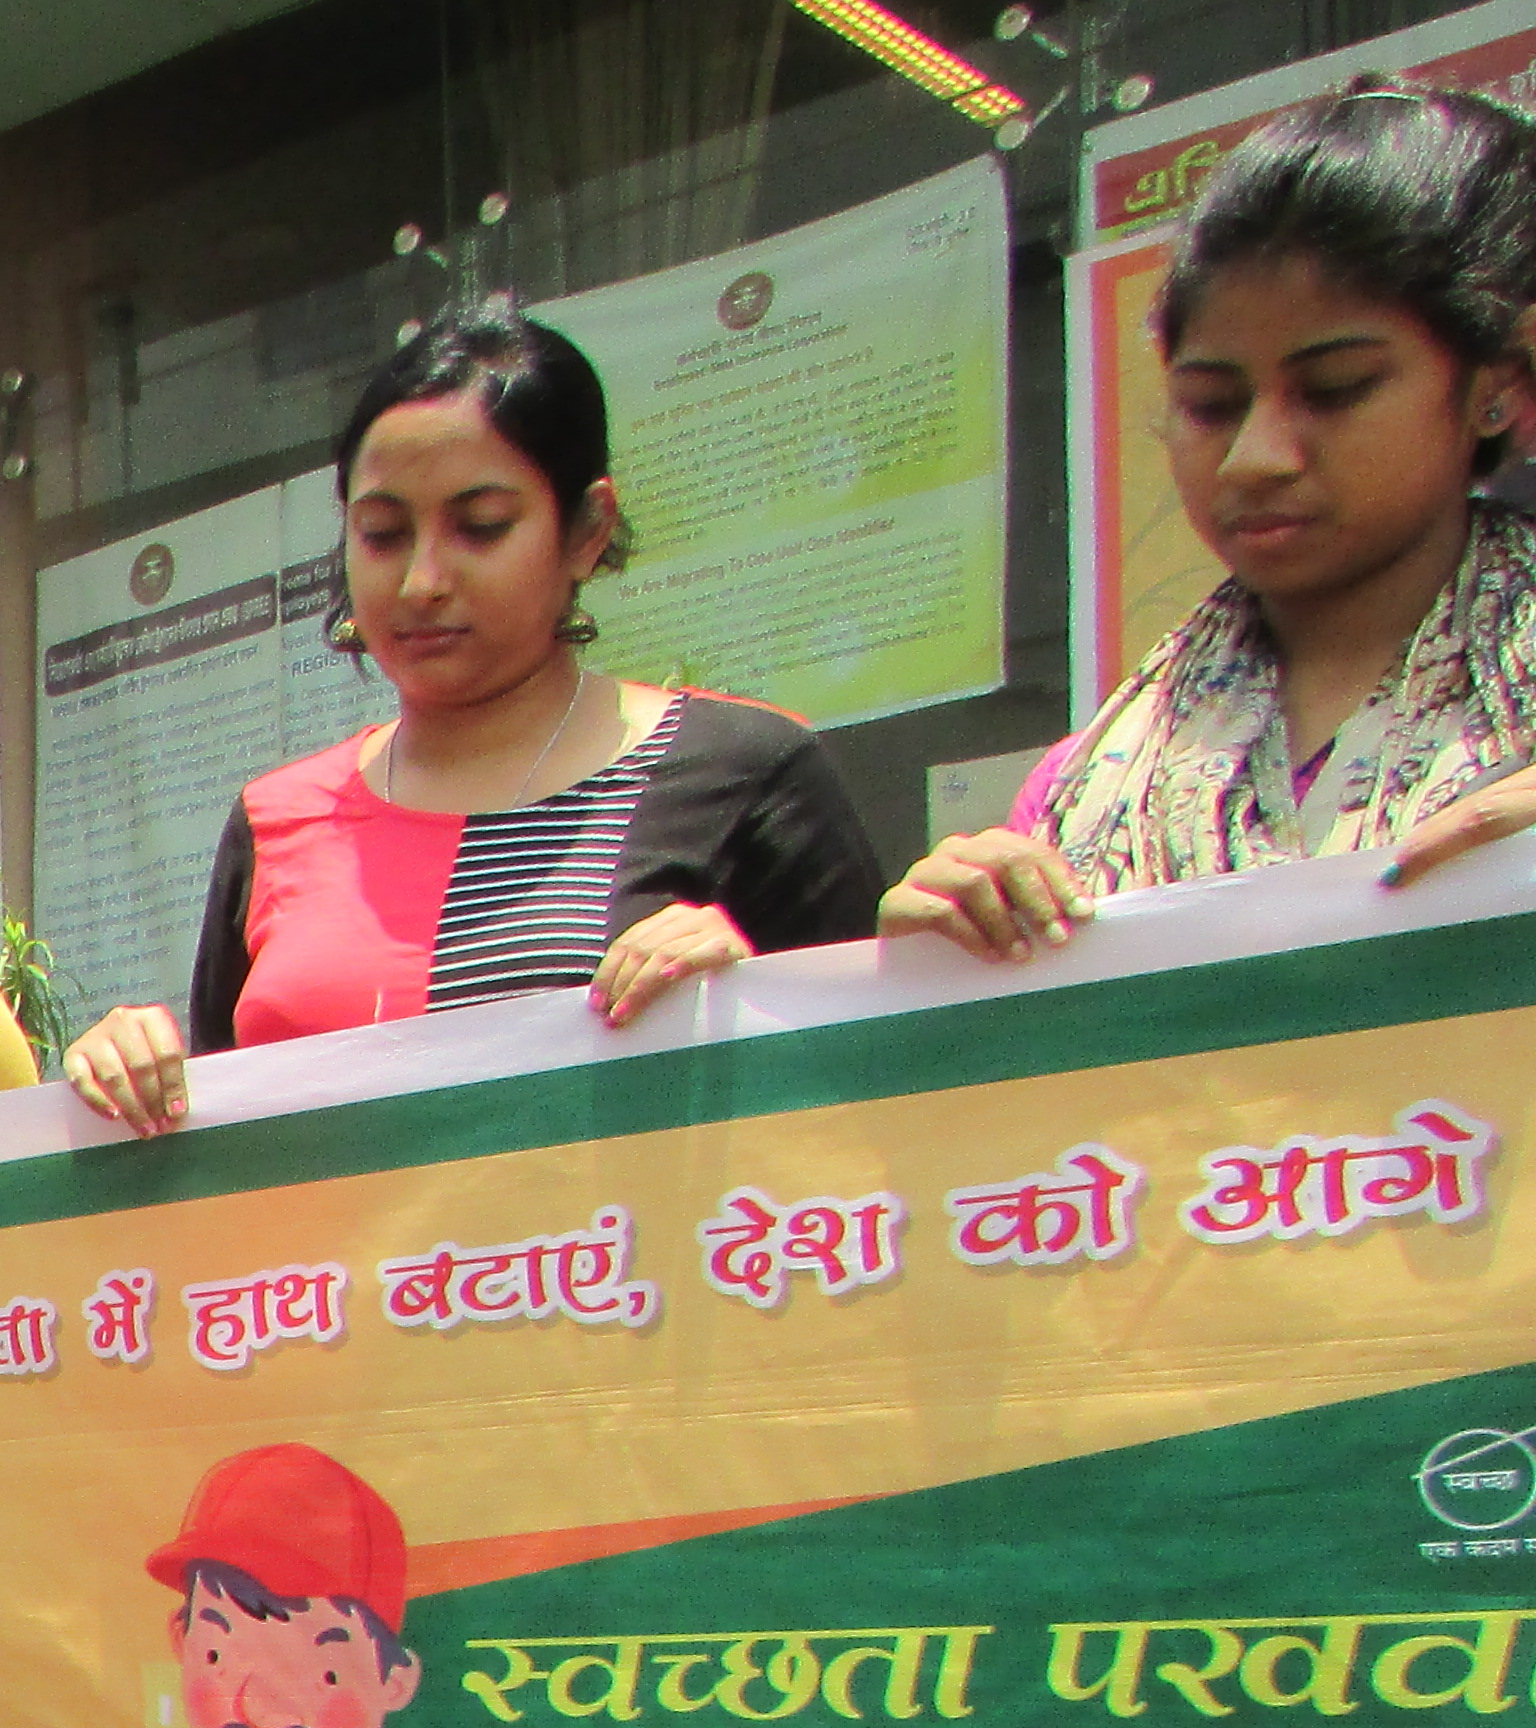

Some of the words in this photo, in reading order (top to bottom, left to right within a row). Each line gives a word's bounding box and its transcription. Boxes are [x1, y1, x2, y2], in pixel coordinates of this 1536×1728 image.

[89, 1276, 146, 1354] में
[188, 1270, 337, 1361] हाथ
[384, 1214, 647, 1320] बटाएं,
[704, 1196, 891, 1298] देश
[955, 1152, 1126, 1254] को
[1190, 1110, 1475, 1231] आगे
[461, 1624, 996, 1722] स्वच्छता
[1047, 1609, 1536, 1716] पखव
